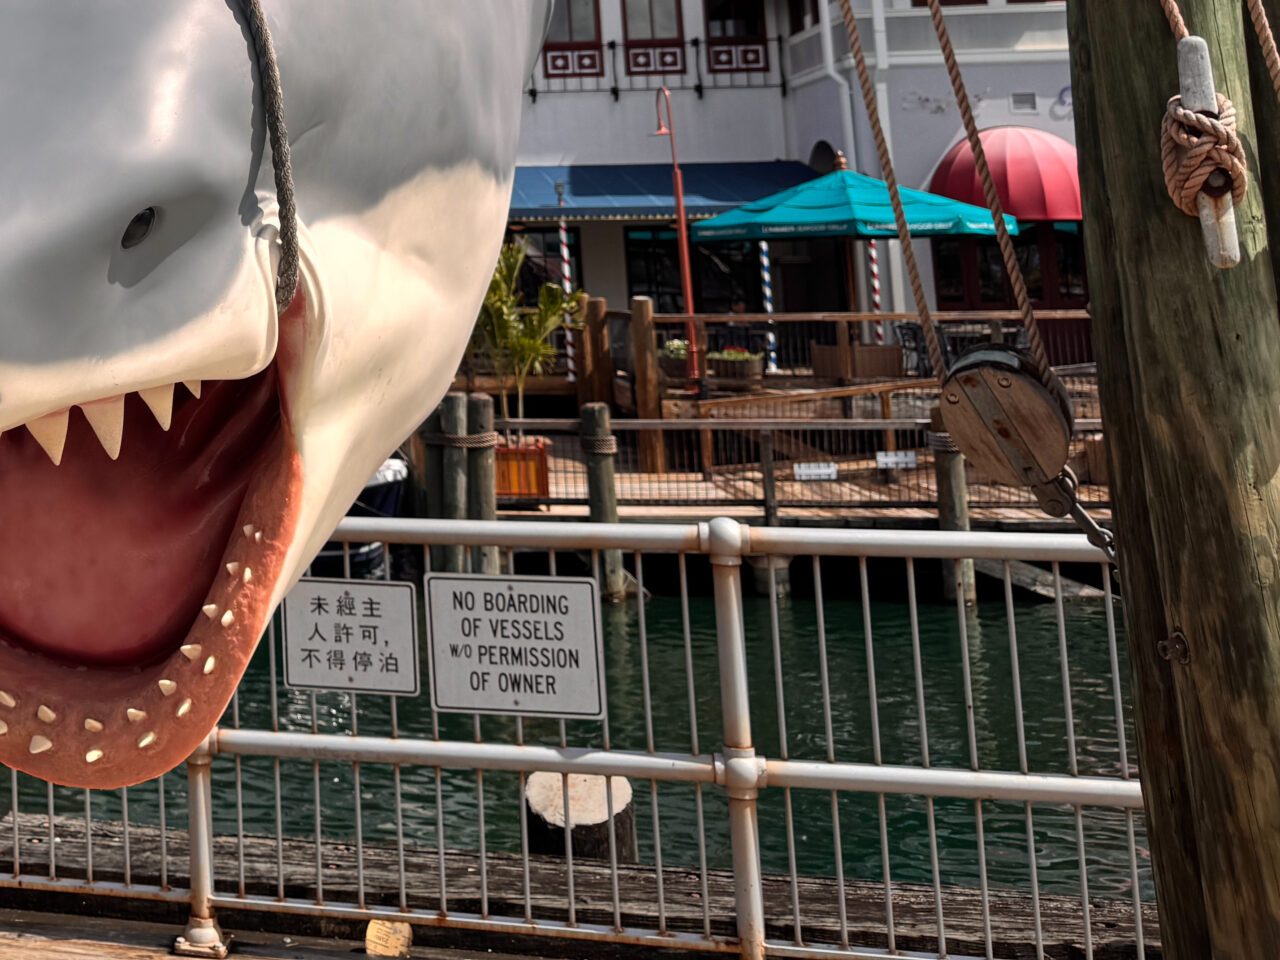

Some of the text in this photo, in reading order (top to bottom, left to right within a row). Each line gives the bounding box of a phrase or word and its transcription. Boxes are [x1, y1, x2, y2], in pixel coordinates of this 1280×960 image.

[310, 594, 382, 618] 未經主
[452, 590, 570, 615] NO BOARDING
[461, 617, 565, 641] OF VESSELS
[300, 648, 400, 673] 不得停泊
[449, 643, 580, 669] W/O PERMISSION
[469, 671, 557, 695] OF OWNER
